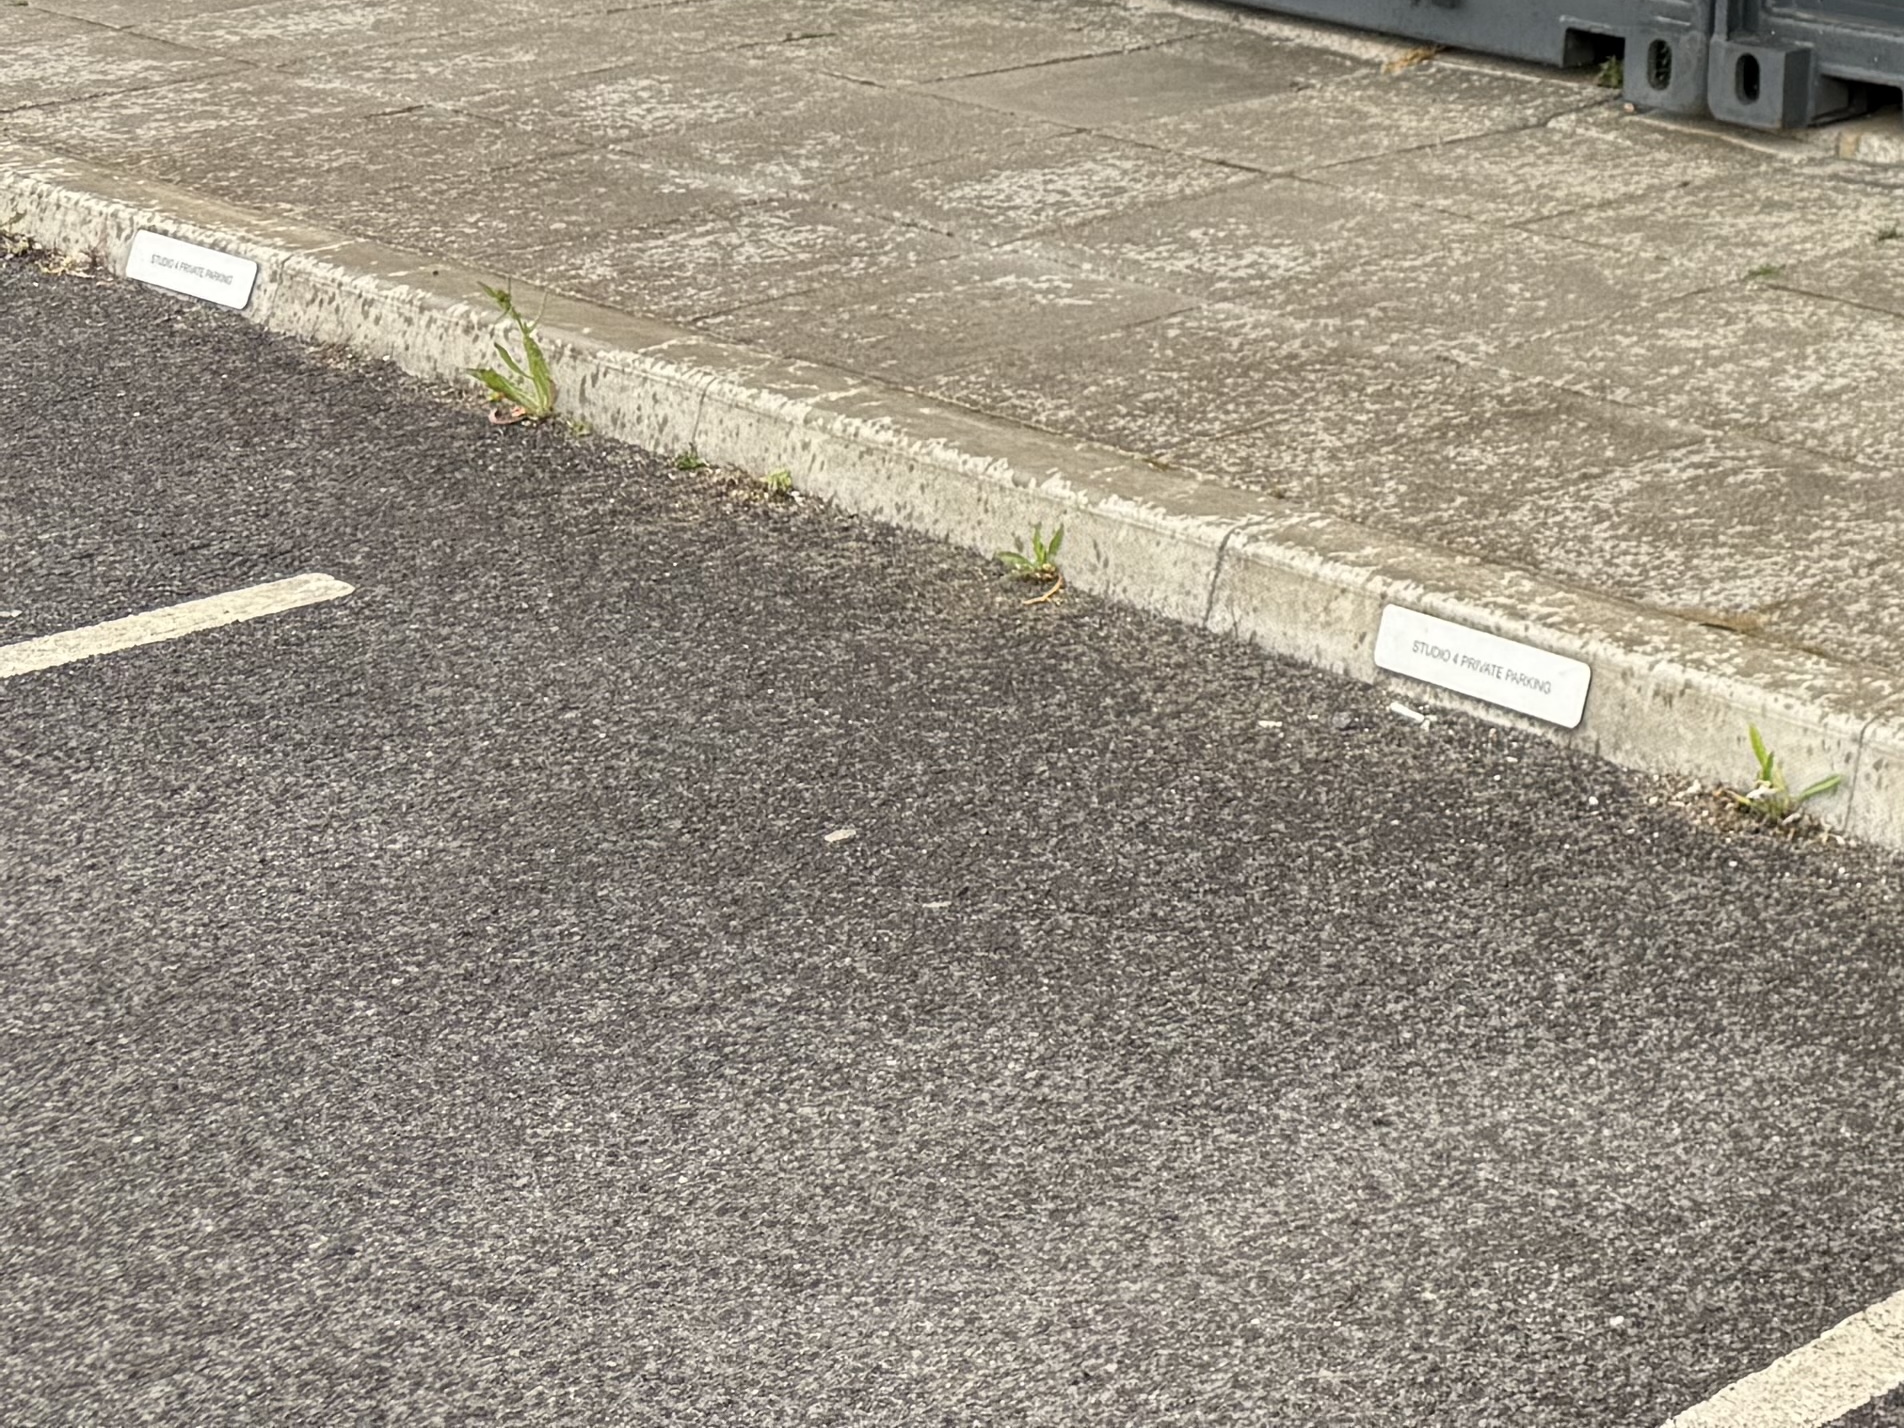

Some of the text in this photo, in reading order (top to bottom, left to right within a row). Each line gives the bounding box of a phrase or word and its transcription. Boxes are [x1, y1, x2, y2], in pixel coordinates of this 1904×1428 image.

[1411, 639, 1552, 695] STUDIO 4 PRIVATE PARKING
